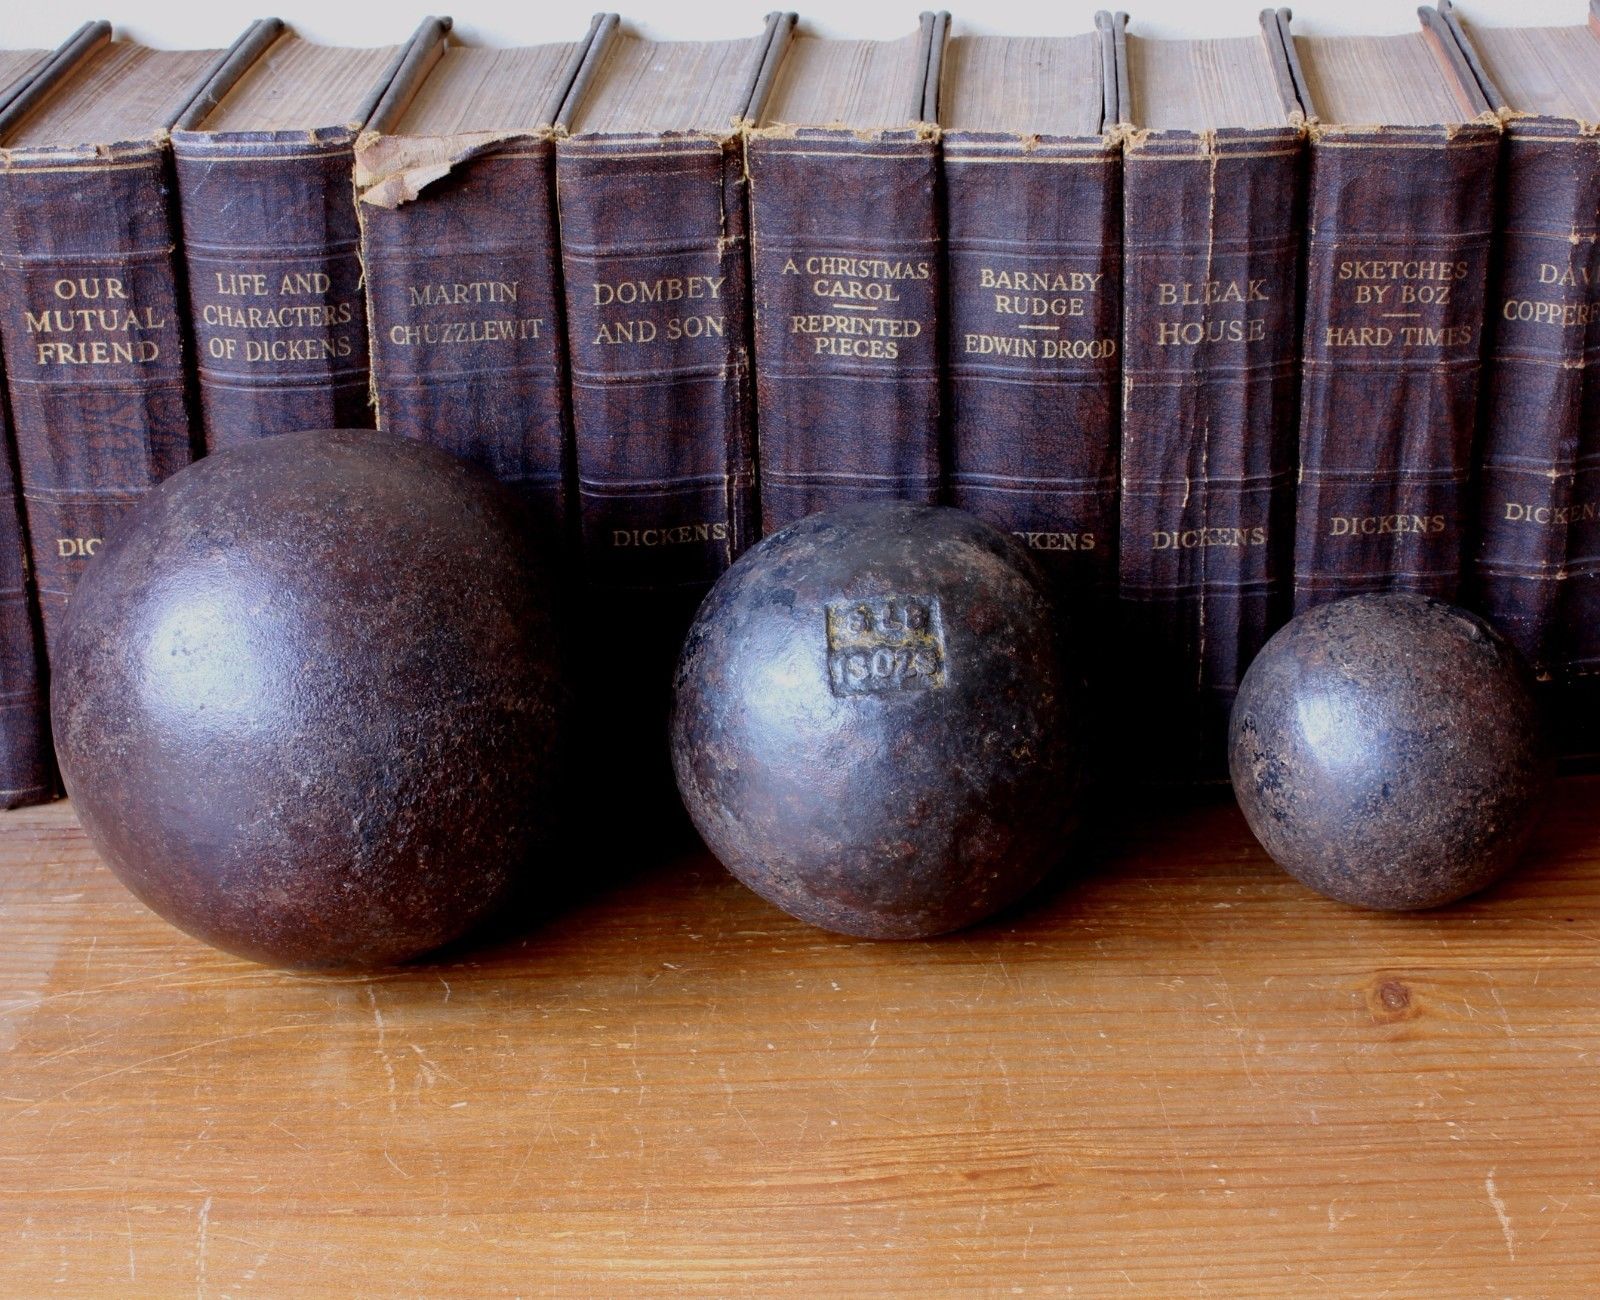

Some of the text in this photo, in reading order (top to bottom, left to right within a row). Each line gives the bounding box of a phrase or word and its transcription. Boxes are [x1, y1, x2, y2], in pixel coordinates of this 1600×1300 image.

[782, 257, 930, 280] A CHRISTMAS
[980, 268, 1104, 292] BARNABY
[1339, 260, 1468, 281] SKETCHES
[54, 278, 128, 300] OUR
[215, 272, 331, 297] LIFE AND
[409, 281, 519, 307] MARTIN
[593, 276, 726, 307] DOMBEY
[813, 279, 900, 302] CAROL
[1158, 279, 1269, 306] BLEAK
[1356, 285, 1451, 305] BY BOZ
[203, 303, 352, 328] CHARACTERS
[995, 294, 1084, 317] RUDGE
[25, 307, 165, 333] MUTUAL
[389, 318, 544, 345] CHUZZLEWIT
[592, 315, 726, 345] AND SON
[792, 315, 921, 338] REPRINTED
[1157, 318, 1266, 346] HOUSE
[1325, 325, 1472, 348] HARD TIMES
[36, 341, 159, 365] FRIEND
[209, 336, 352, 362] OF DICKENS
[815, 337, 899, 360] PIECES
[964, 335, 1116, 360] EDWIN DROOD
[1504, 502, 1600, 524] DICKEN
[613, 522, 727, 547] DICKENS
[1331, 515, 1445, 537] DICKENS
[57, 538, 104, 556] DIC
[1012, 531, 1096, 550] KENS
[1152, 527, 1265, 550] DICKENS
